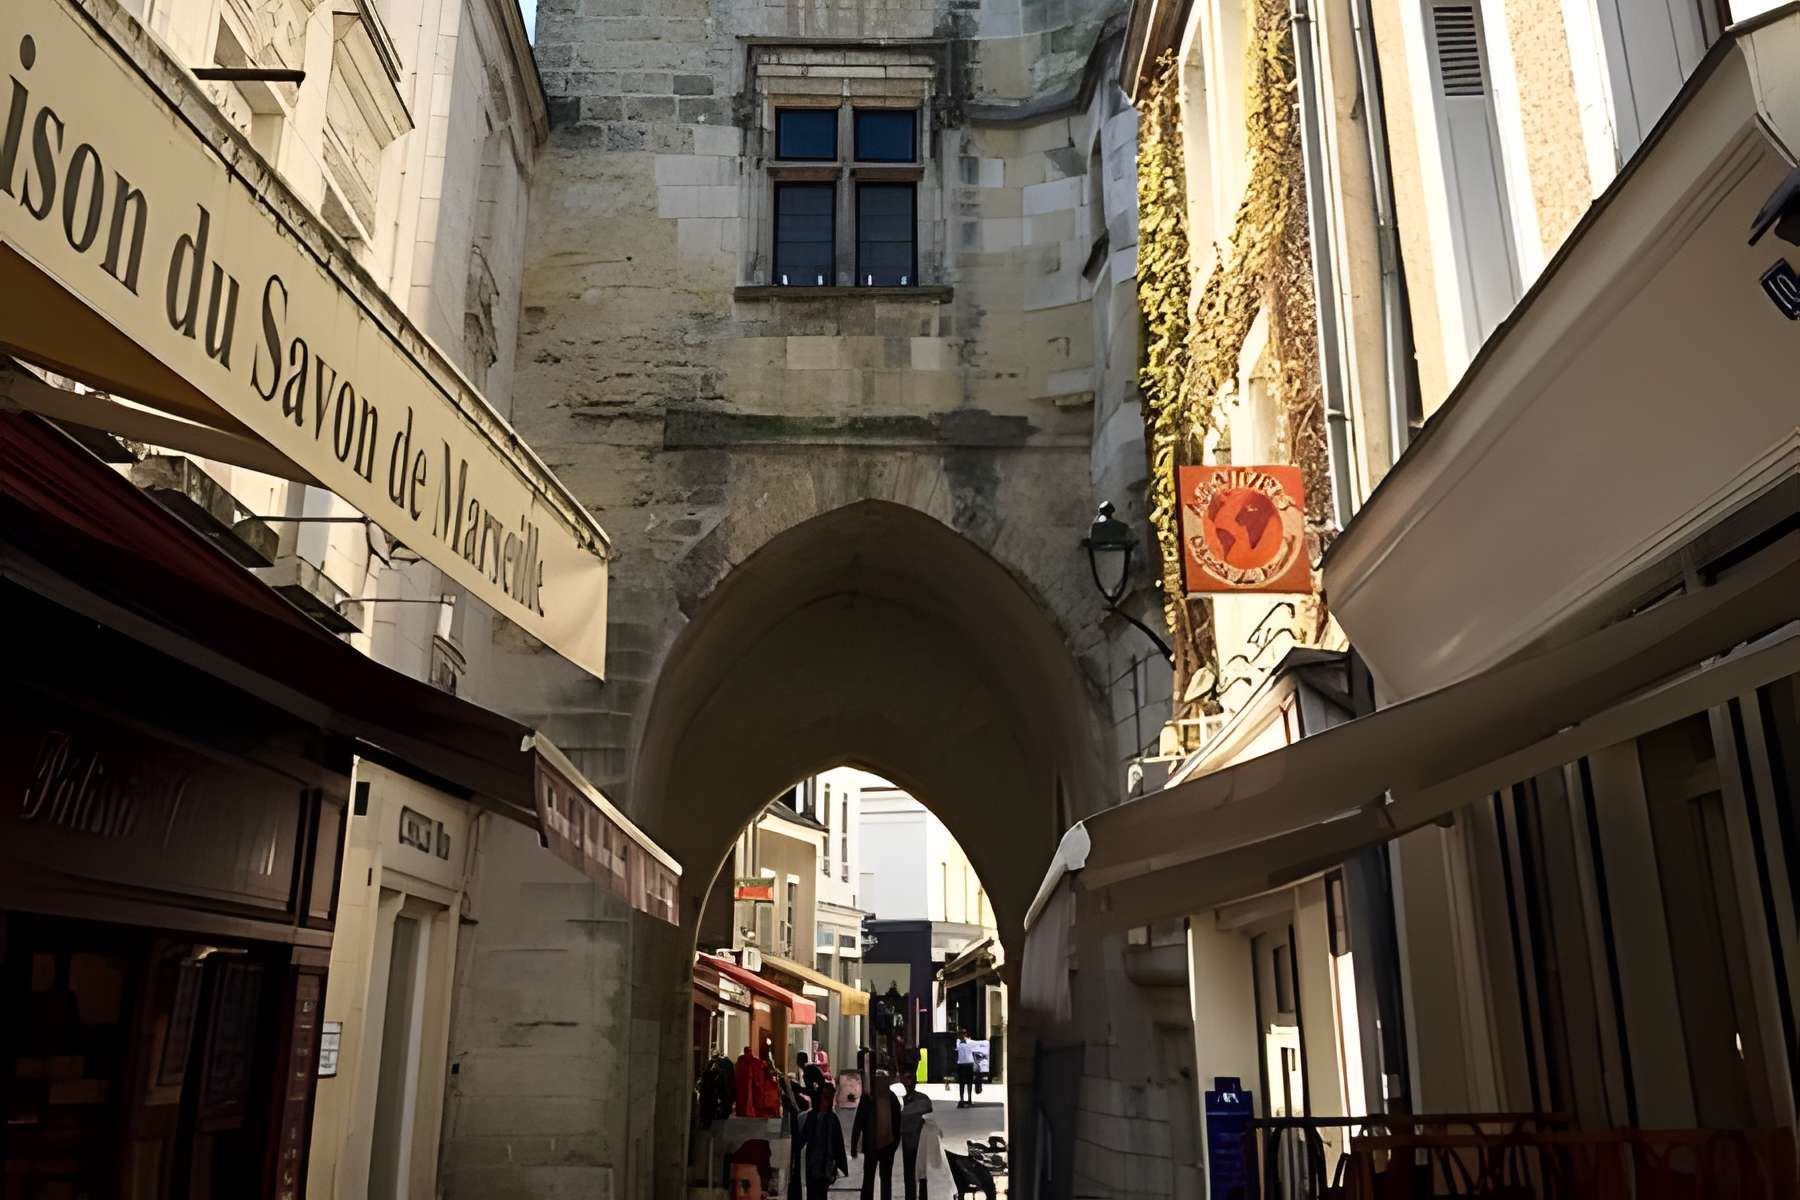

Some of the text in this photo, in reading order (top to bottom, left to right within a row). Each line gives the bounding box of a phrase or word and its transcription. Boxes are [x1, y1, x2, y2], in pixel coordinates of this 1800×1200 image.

[166, 203, 240, 372] du
[250, 274, 378, 483] Savon
[388, 406, 427, 522] de
